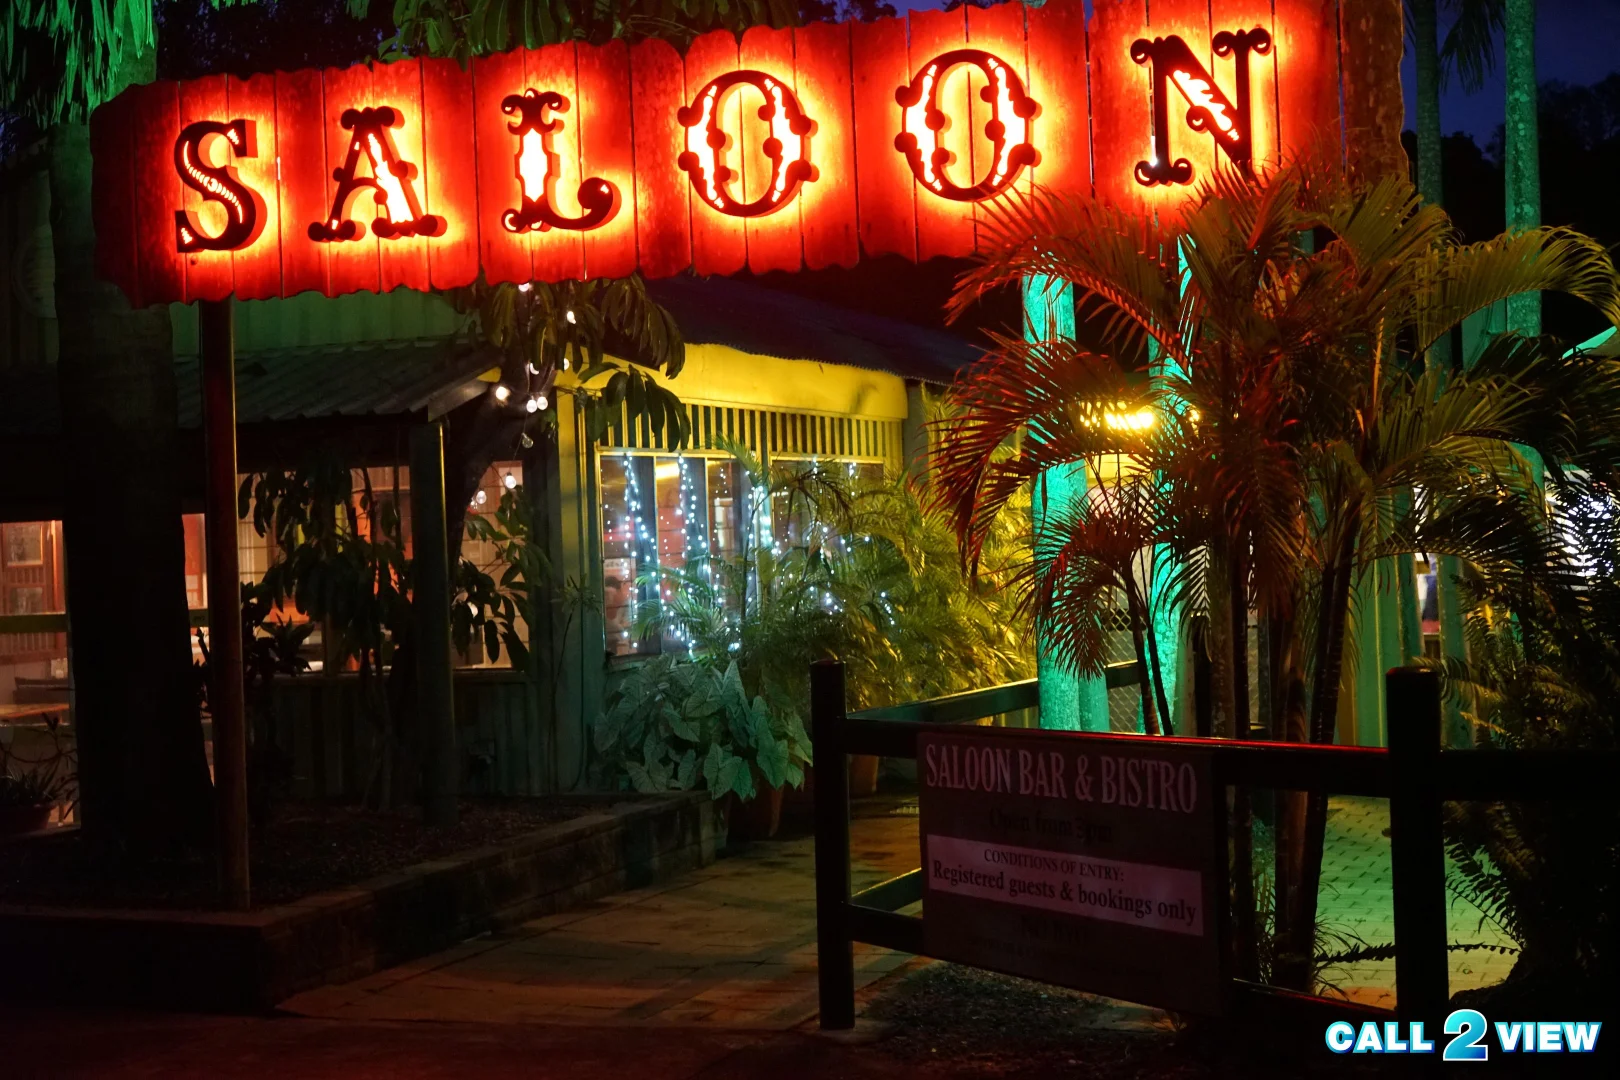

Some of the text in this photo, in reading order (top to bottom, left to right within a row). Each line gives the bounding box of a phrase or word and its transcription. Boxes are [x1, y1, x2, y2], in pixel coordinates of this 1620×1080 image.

[173, 27, 1272, 254] SALOON
[926, 743, 1198, 815] SALOON BAR & BISTRO
[989, 808, 1031, 838] Open
[933, 859, 1197, 926] Registered guests & bookings only
[983, 849, 1124, 882] CONDITIONS OF ENTRY:
